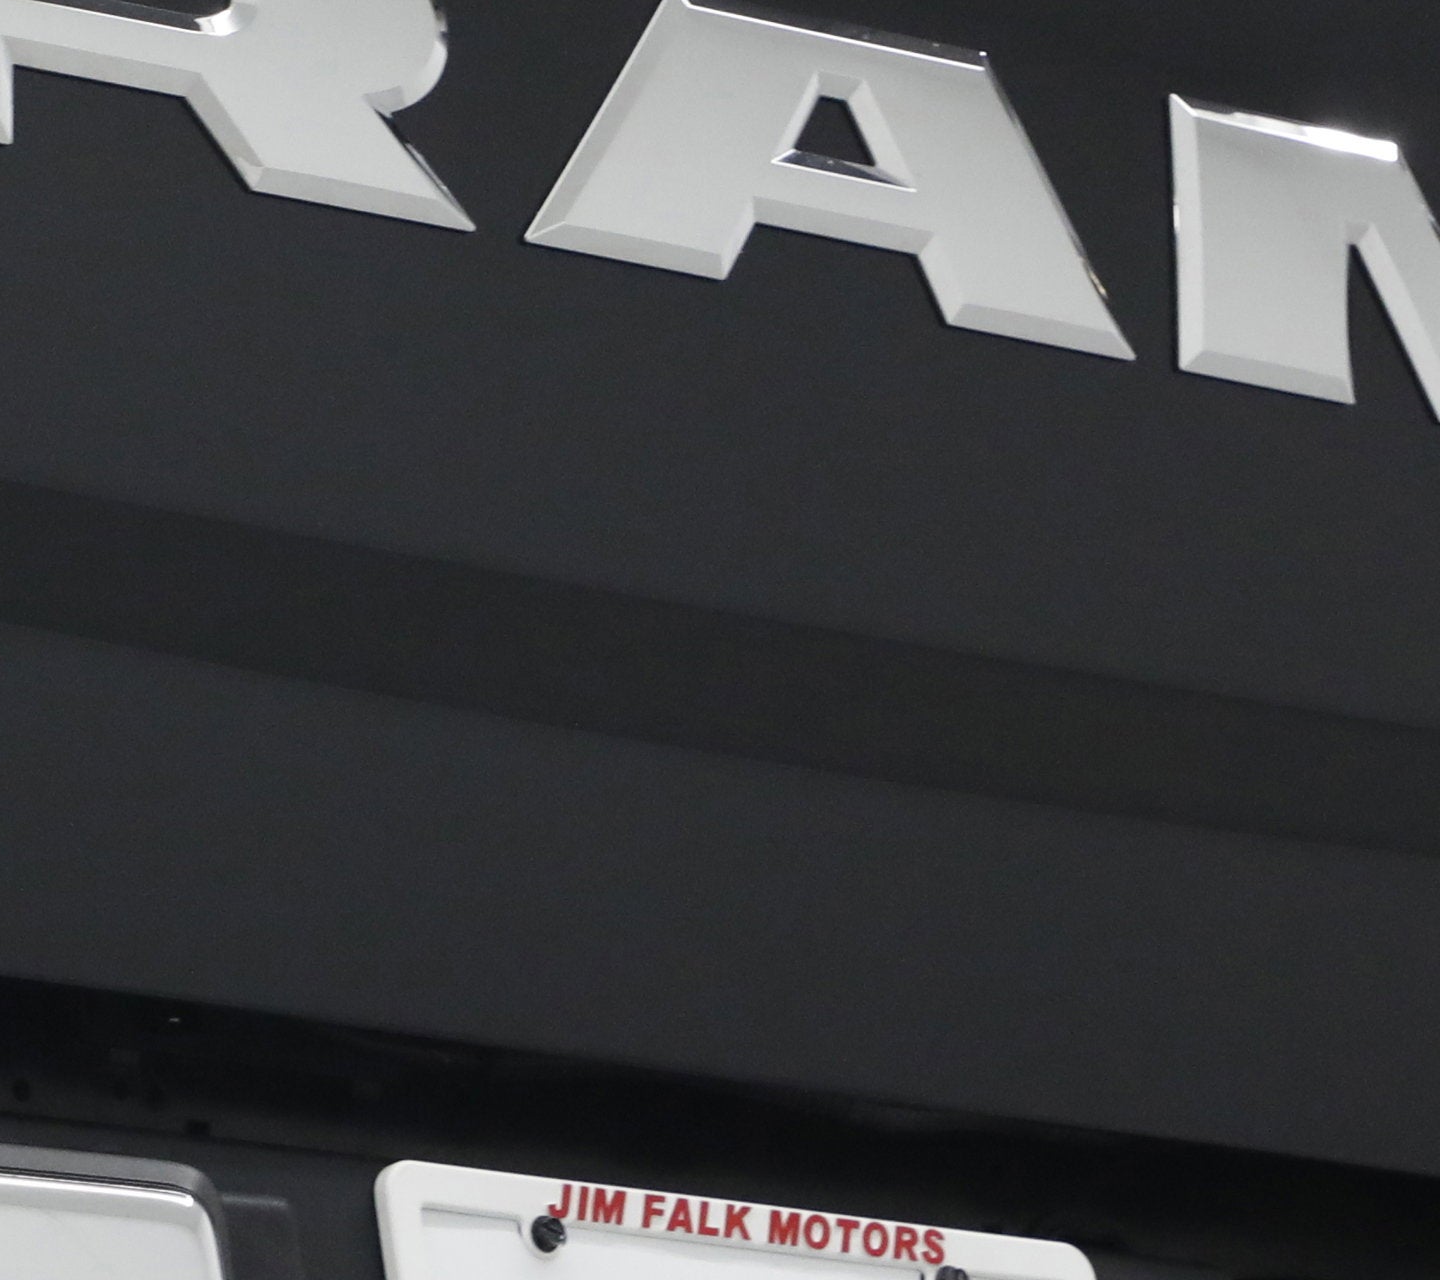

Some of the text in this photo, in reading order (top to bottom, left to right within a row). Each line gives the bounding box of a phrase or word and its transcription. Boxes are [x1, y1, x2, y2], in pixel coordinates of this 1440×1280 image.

[547, 1183, 946, 1266] JIM FALK MOTORS
